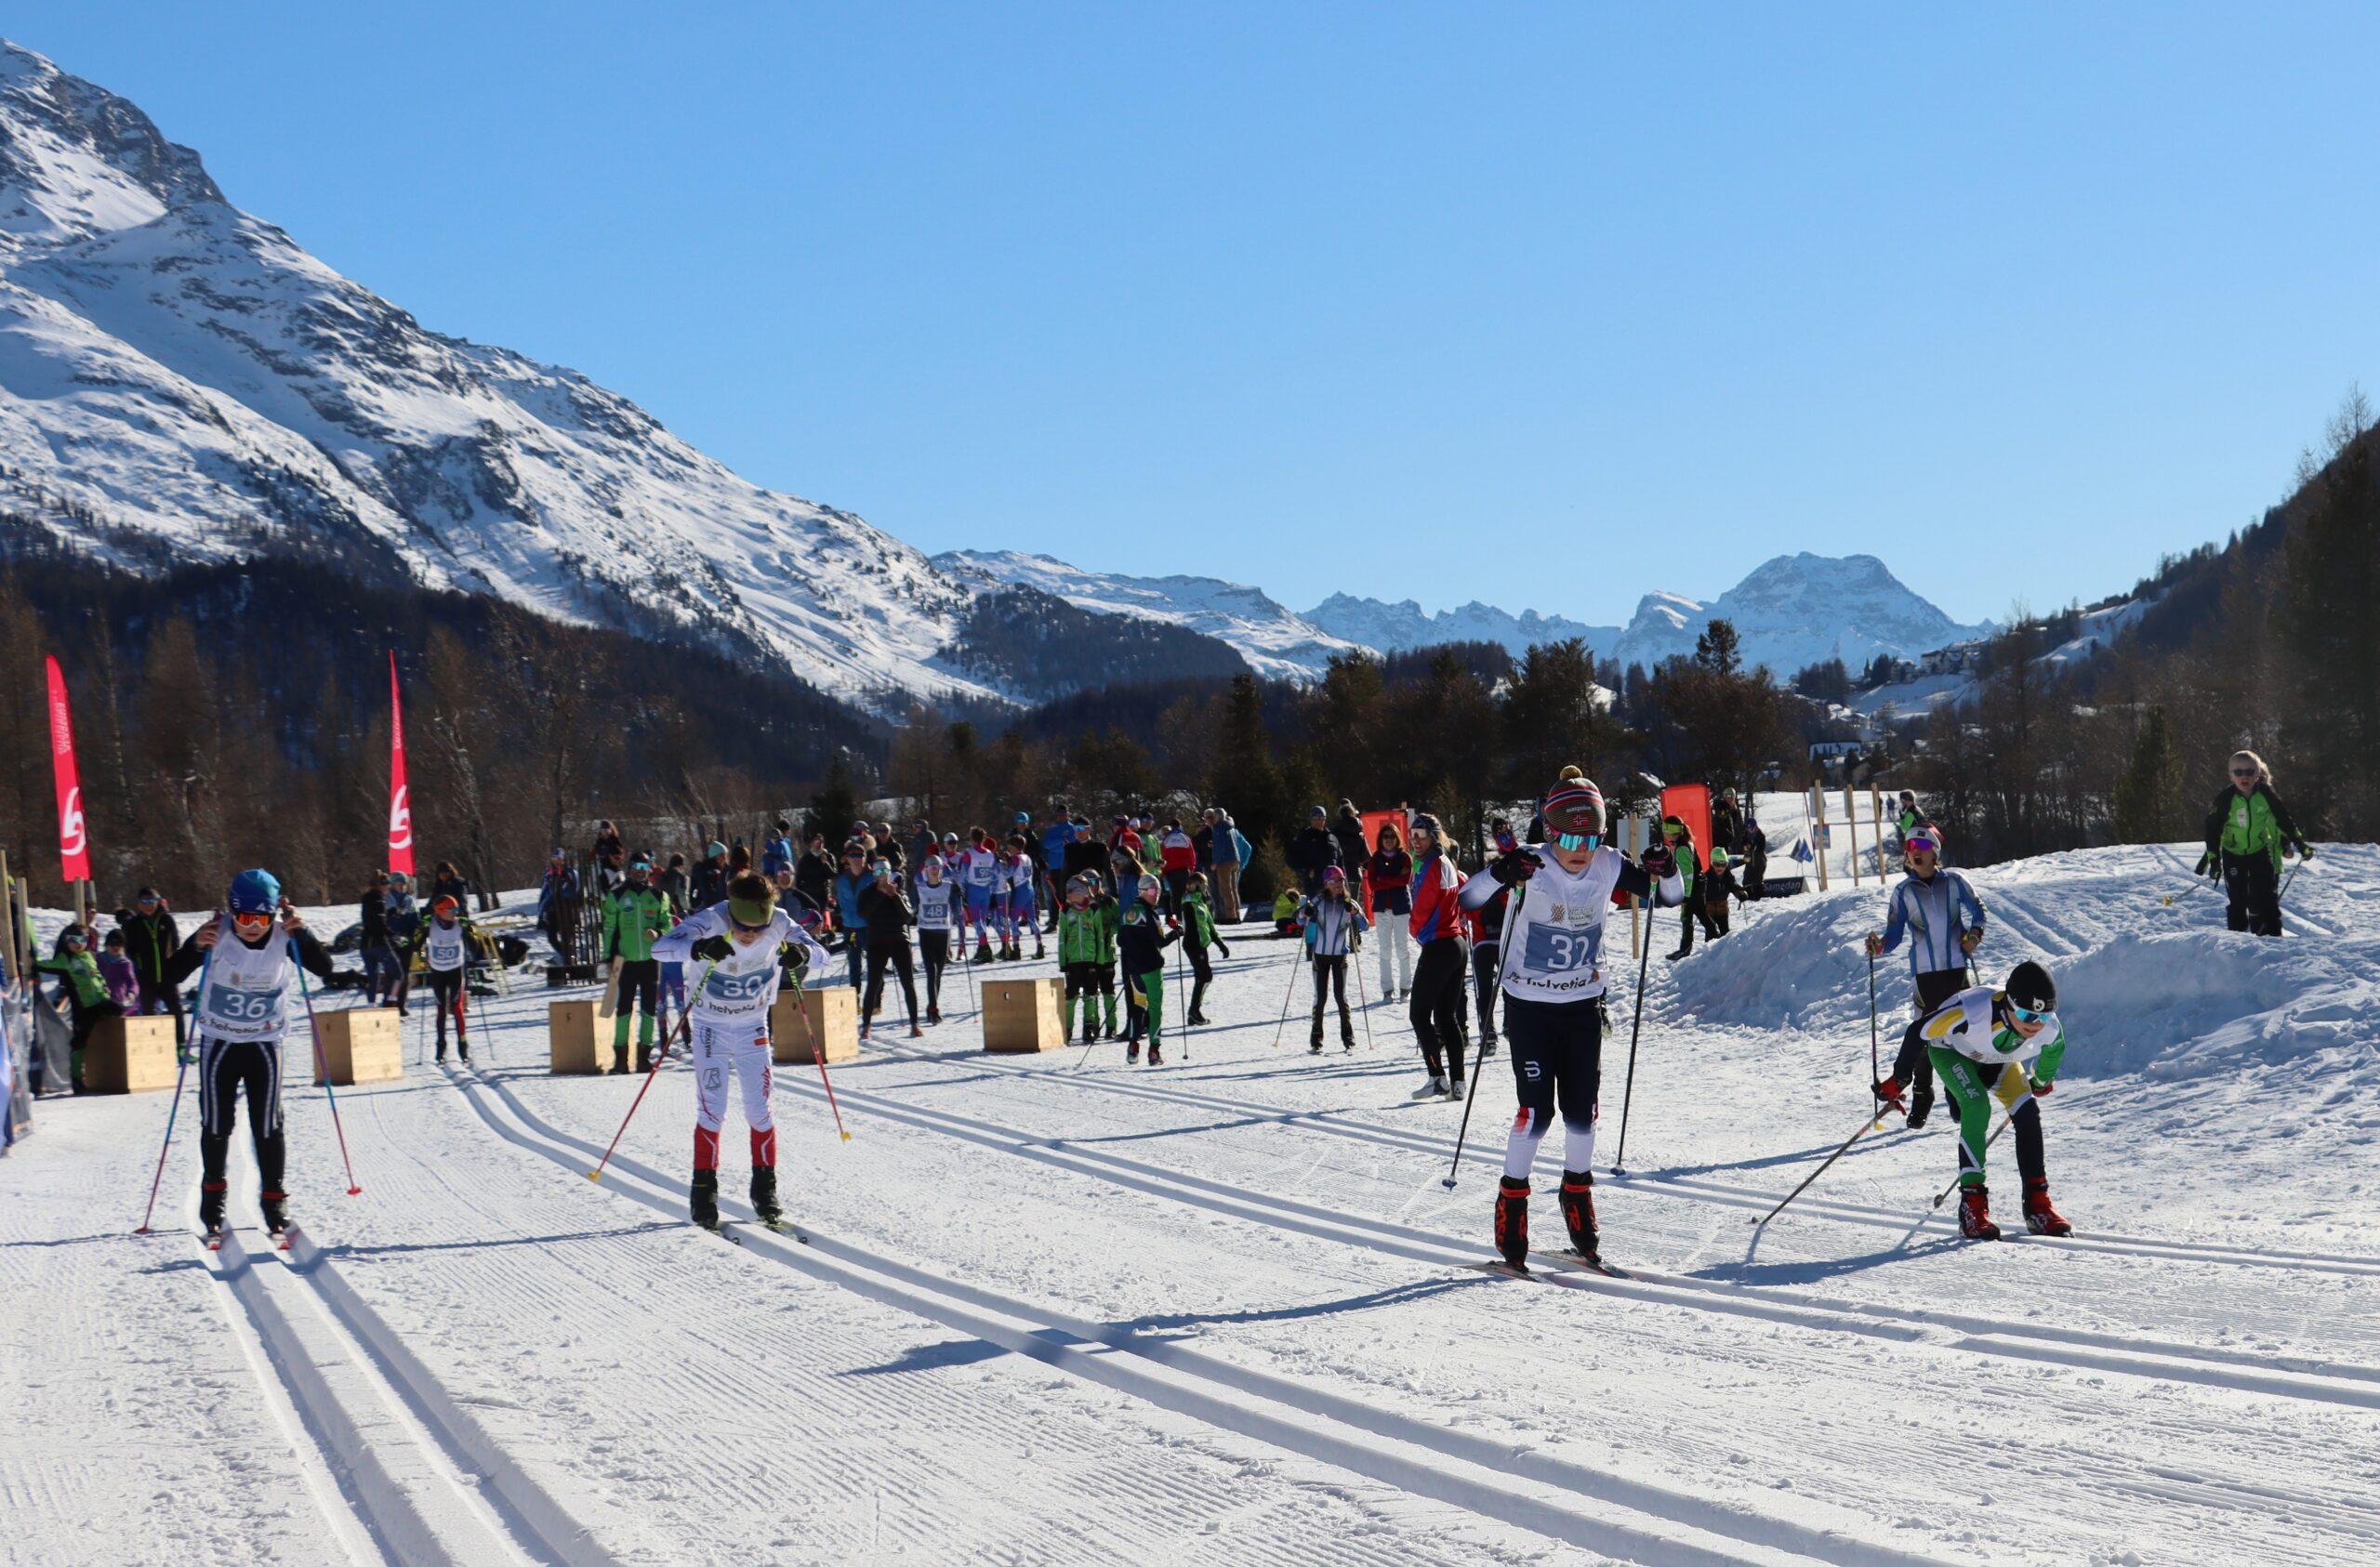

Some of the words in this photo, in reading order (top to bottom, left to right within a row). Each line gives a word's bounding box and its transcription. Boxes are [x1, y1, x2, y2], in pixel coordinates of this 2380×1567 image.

[927, 905, 943, 916] 48
[437, 948, 456, 959] 50
[1547, 934, 1591, 969] 32
[224, 994, 266, 1019] 36
